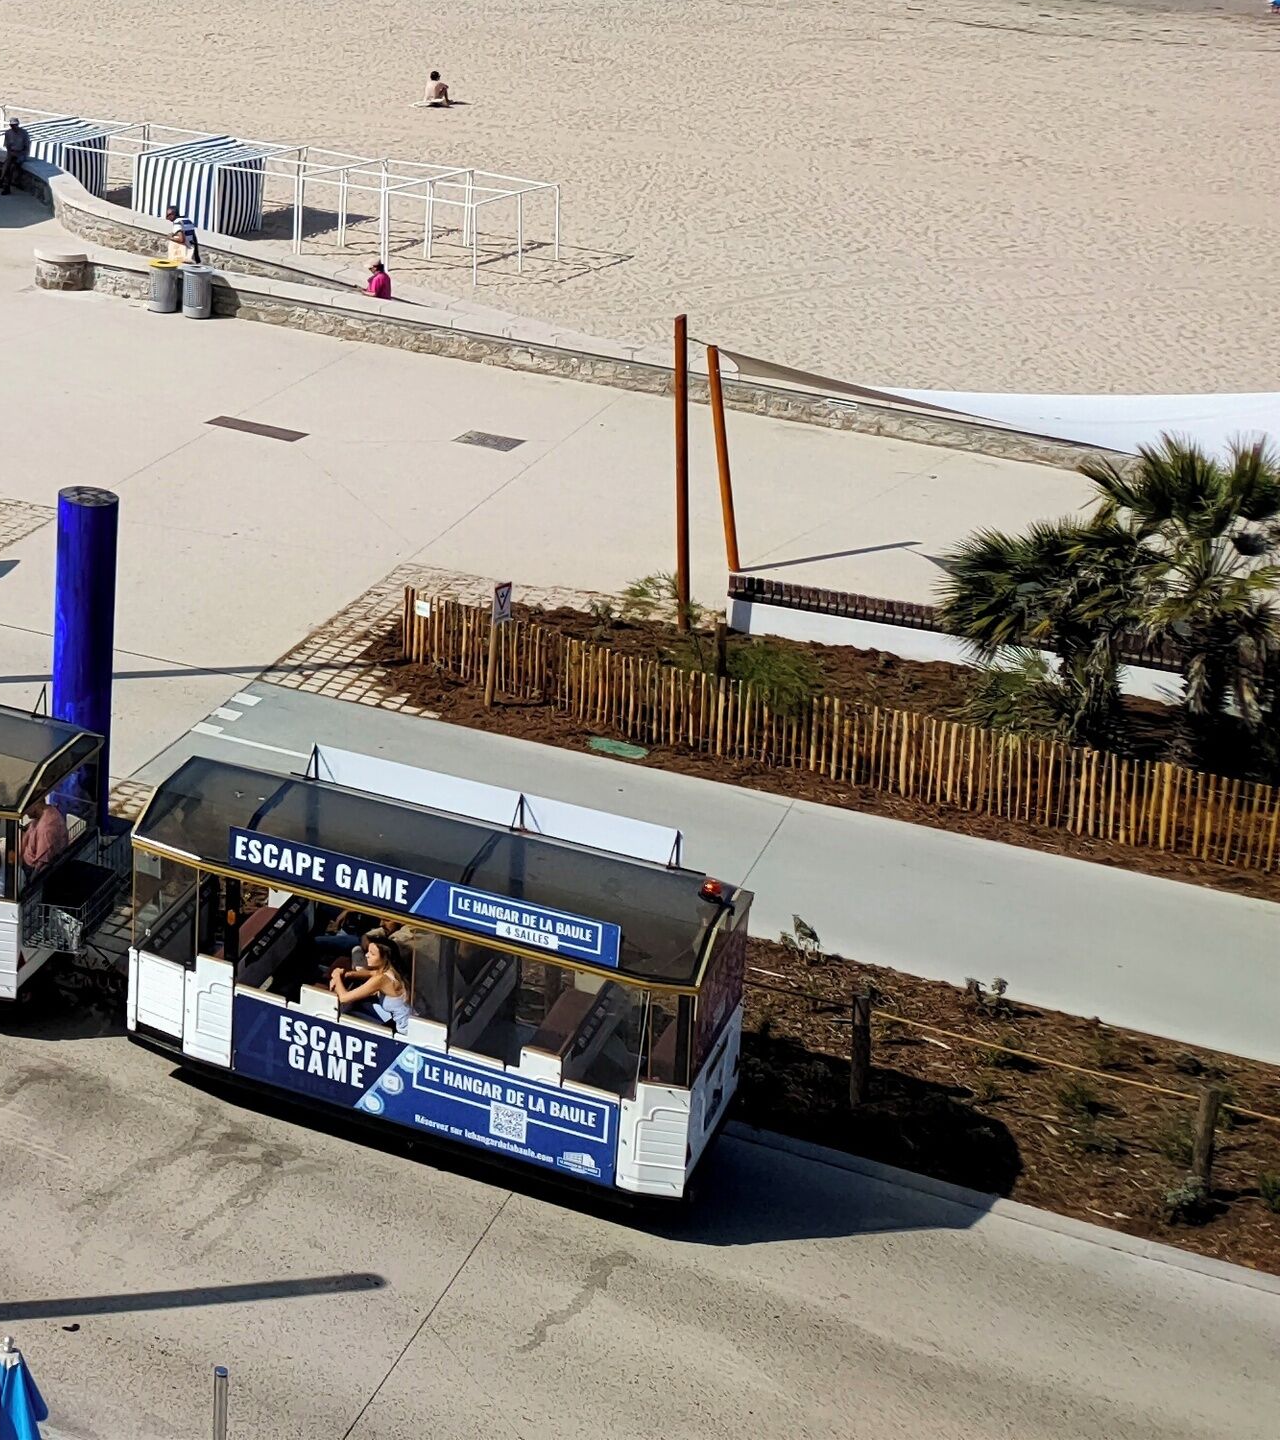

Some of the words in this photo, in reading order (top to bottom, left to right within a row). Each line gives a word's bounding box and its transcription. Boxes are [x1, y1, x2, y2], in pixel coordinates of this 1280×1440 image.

[234, 835, 326, 882] ESCAPE
[335, 863, 409, 904] GAME
[457, 897, 470, 912] LE
[473, 900, 519, 924] HANGAR
[522, 914, 538, 928] DE
[540, 918, 552, 933] LA
[556, 922, 592, 942] BAULE
[505, 926, 511, 936] 4
[514, 928, 549, 946] SALLES
[279, 1015, 378, 1068] ESCAPE
[288, 1044, 364, 1089] GAME
[424, 1064, 440, 1082] LE
[444, 1069, 502, 1101] HANGAR
[506, 1089, 525, 1108] DE
[528, 1095, 545, 1114] LA
[550, 1101, 597, 1128] BAULE
[415, 1114, 449, 1132] Réservez
[450, 1127, 463, 1136] sur
